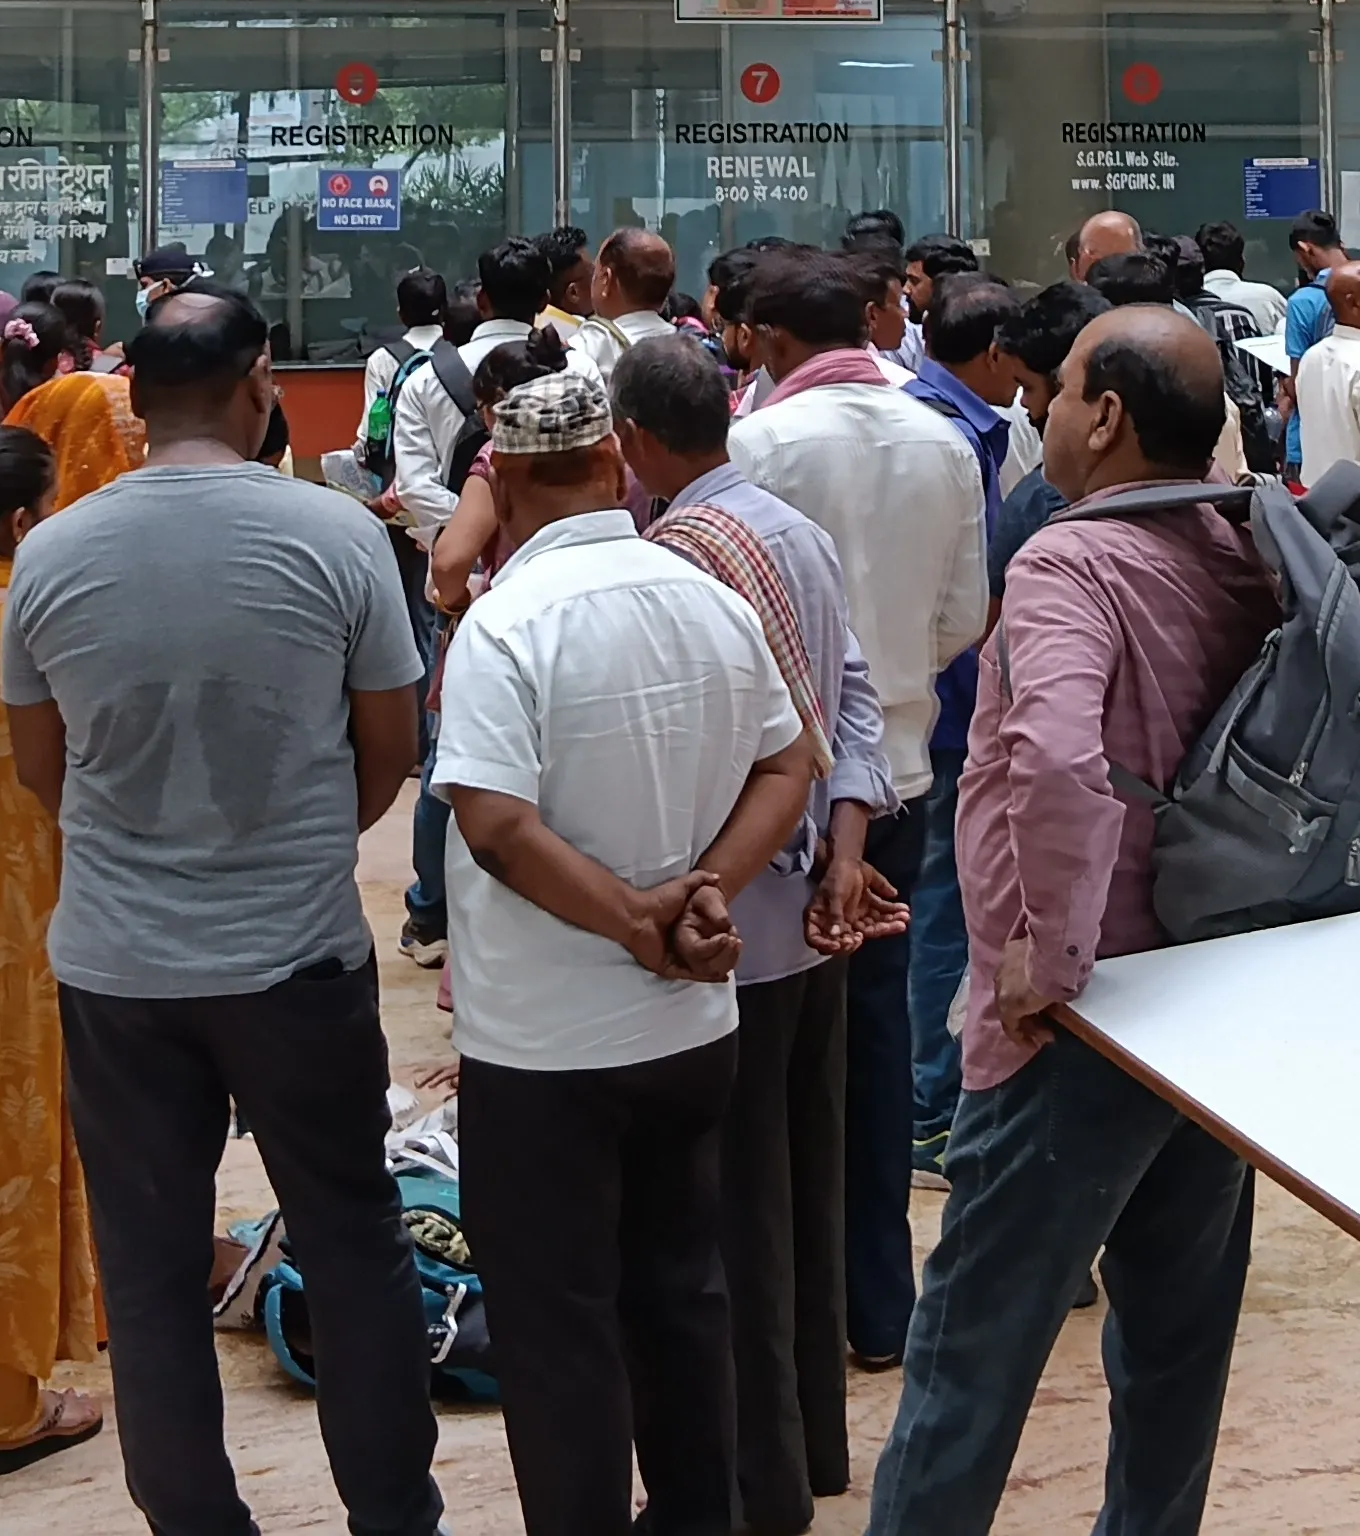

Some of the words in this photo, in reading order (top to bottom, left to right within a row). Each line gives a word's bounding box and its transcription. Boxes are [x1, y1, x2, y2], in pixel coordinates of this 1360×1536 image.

[751, 72, 769, 95] 7
[271, 124, 454, 147] REGISTRATION
[675, 122, 849, 144] REGISTRATION
[1062, 122, 1206, 143] REGISTRATION
[707, 156, 816, 179] RENEWAL
[1126, 151, 1148, 168] Web
[8, 156, 111, 196] रजिस्ट्रेशन
[1071, 178, 1102, 191] www.
[1162, 173, 1175, 191] IN
[715, 185, 749, 202] 8:00
[753, 183, 767, 202] से
[770, 185, 808, 202] 4:00
[249, 201, 275, 214] ELP
[322, 198, 336, 209] NO
[339, 198, 362, 209] FACE
[334, 215, 348, 225] NO
[350, 215, 383, 226] ENTRY
